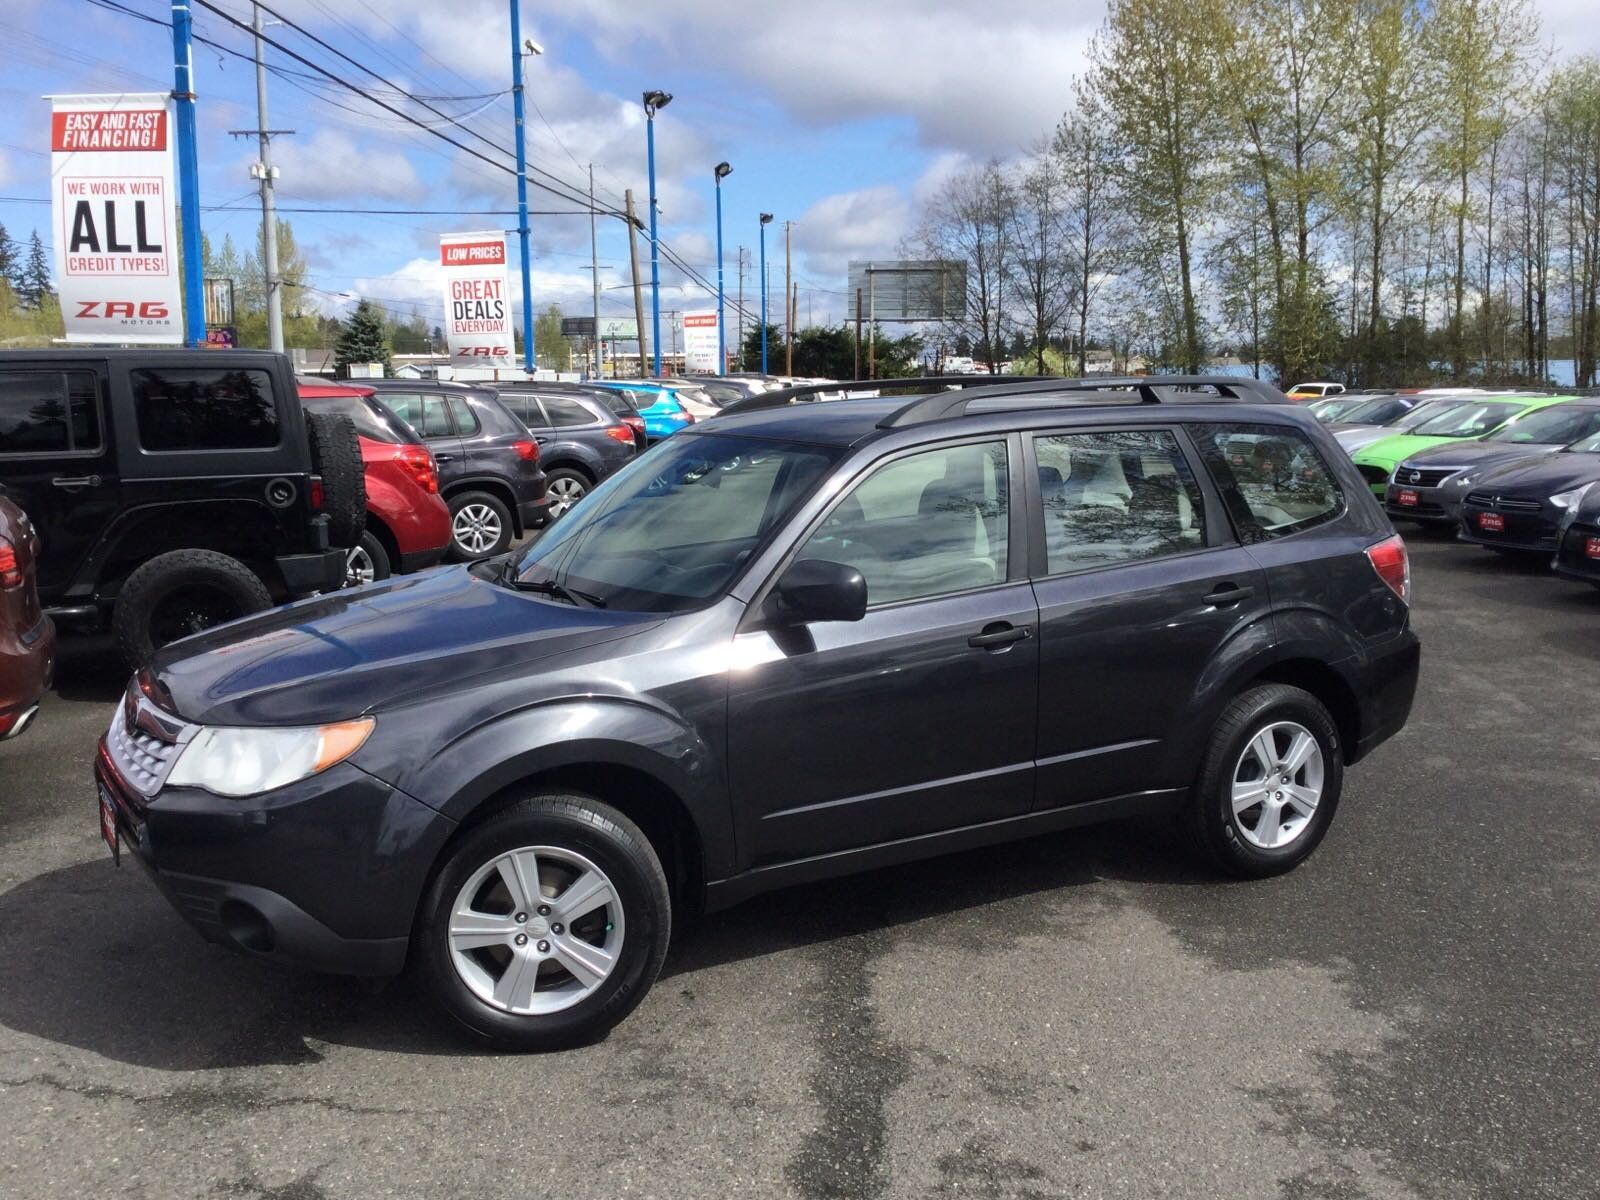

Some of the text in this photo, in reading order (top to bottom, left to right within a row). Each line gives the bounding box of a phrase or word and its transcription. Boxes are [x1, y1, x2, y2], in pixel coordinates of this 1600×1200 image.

[66, 112, 160, 130] EASY AND FAST
[63, 130, 157, 148] FINANCING!
[67, 183, 160, 195] WE WORK WITH
[70, 200, 162, 253] ALL
[447, 247, 501, 260] LOW PRICES
[70, 257, 164, 271] CREDIT TYPES!
[452, 280, 501, 300] GREAT
[75, 301, 169, 318] ZAG
[453, 300, 504, 320] DEALS
[455, 320, 505, 333] EVERYDAY
[457, 346, 509, 356] ZAG
